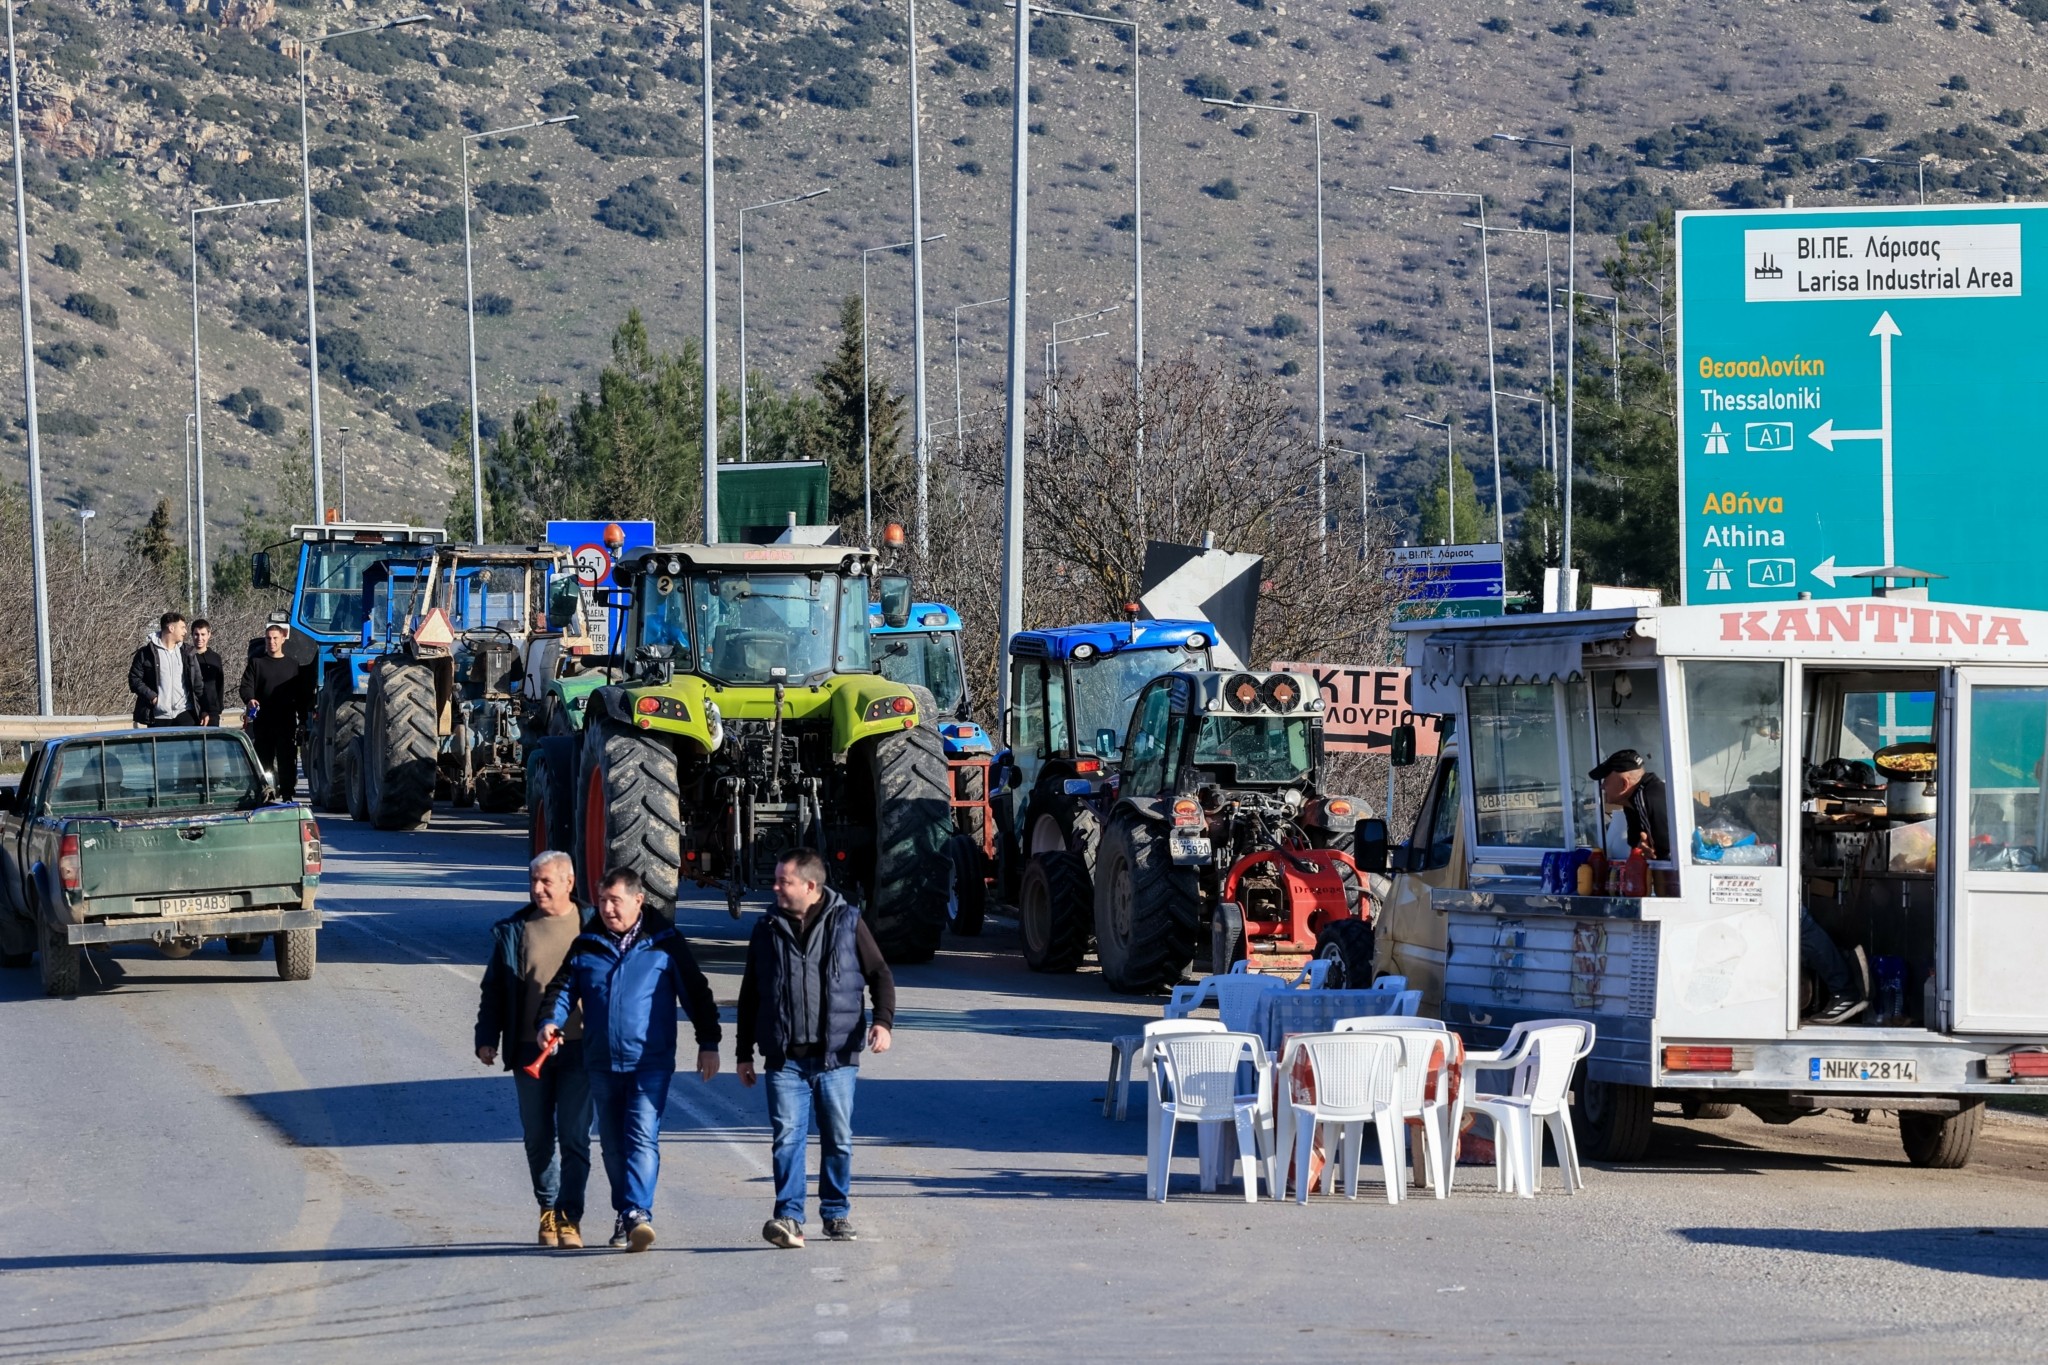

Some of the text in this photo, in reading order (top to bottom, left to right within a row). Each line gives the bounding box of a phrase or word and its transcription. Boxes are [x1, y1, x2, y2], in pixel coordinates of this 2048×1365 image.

[1797, 235, 1941, 261] ΒΙ.ΠΕ. Λάρισας
[1797, 266, 2014, 293] Larisa Industrial Area
[1699, 354, 1825, 379] Θεσσαλονίκη
[1700, 386, 1821, 412] Thessaloniki
[1759, 428, 1781, 446] A1
[1702, 491, 1784, 515] Αθήνα
[1702, 525, 1785, 548] Athina
[660, 578, 670, 592] 2
[1761, 564, 1783, 582] A1
[1719, 603, 2029, 646] ΚΑΝΤΙΝΑ
[1312, 668, 1412, 706] ΚΤΕ
[1180, 844, 1210, 855] 75920
